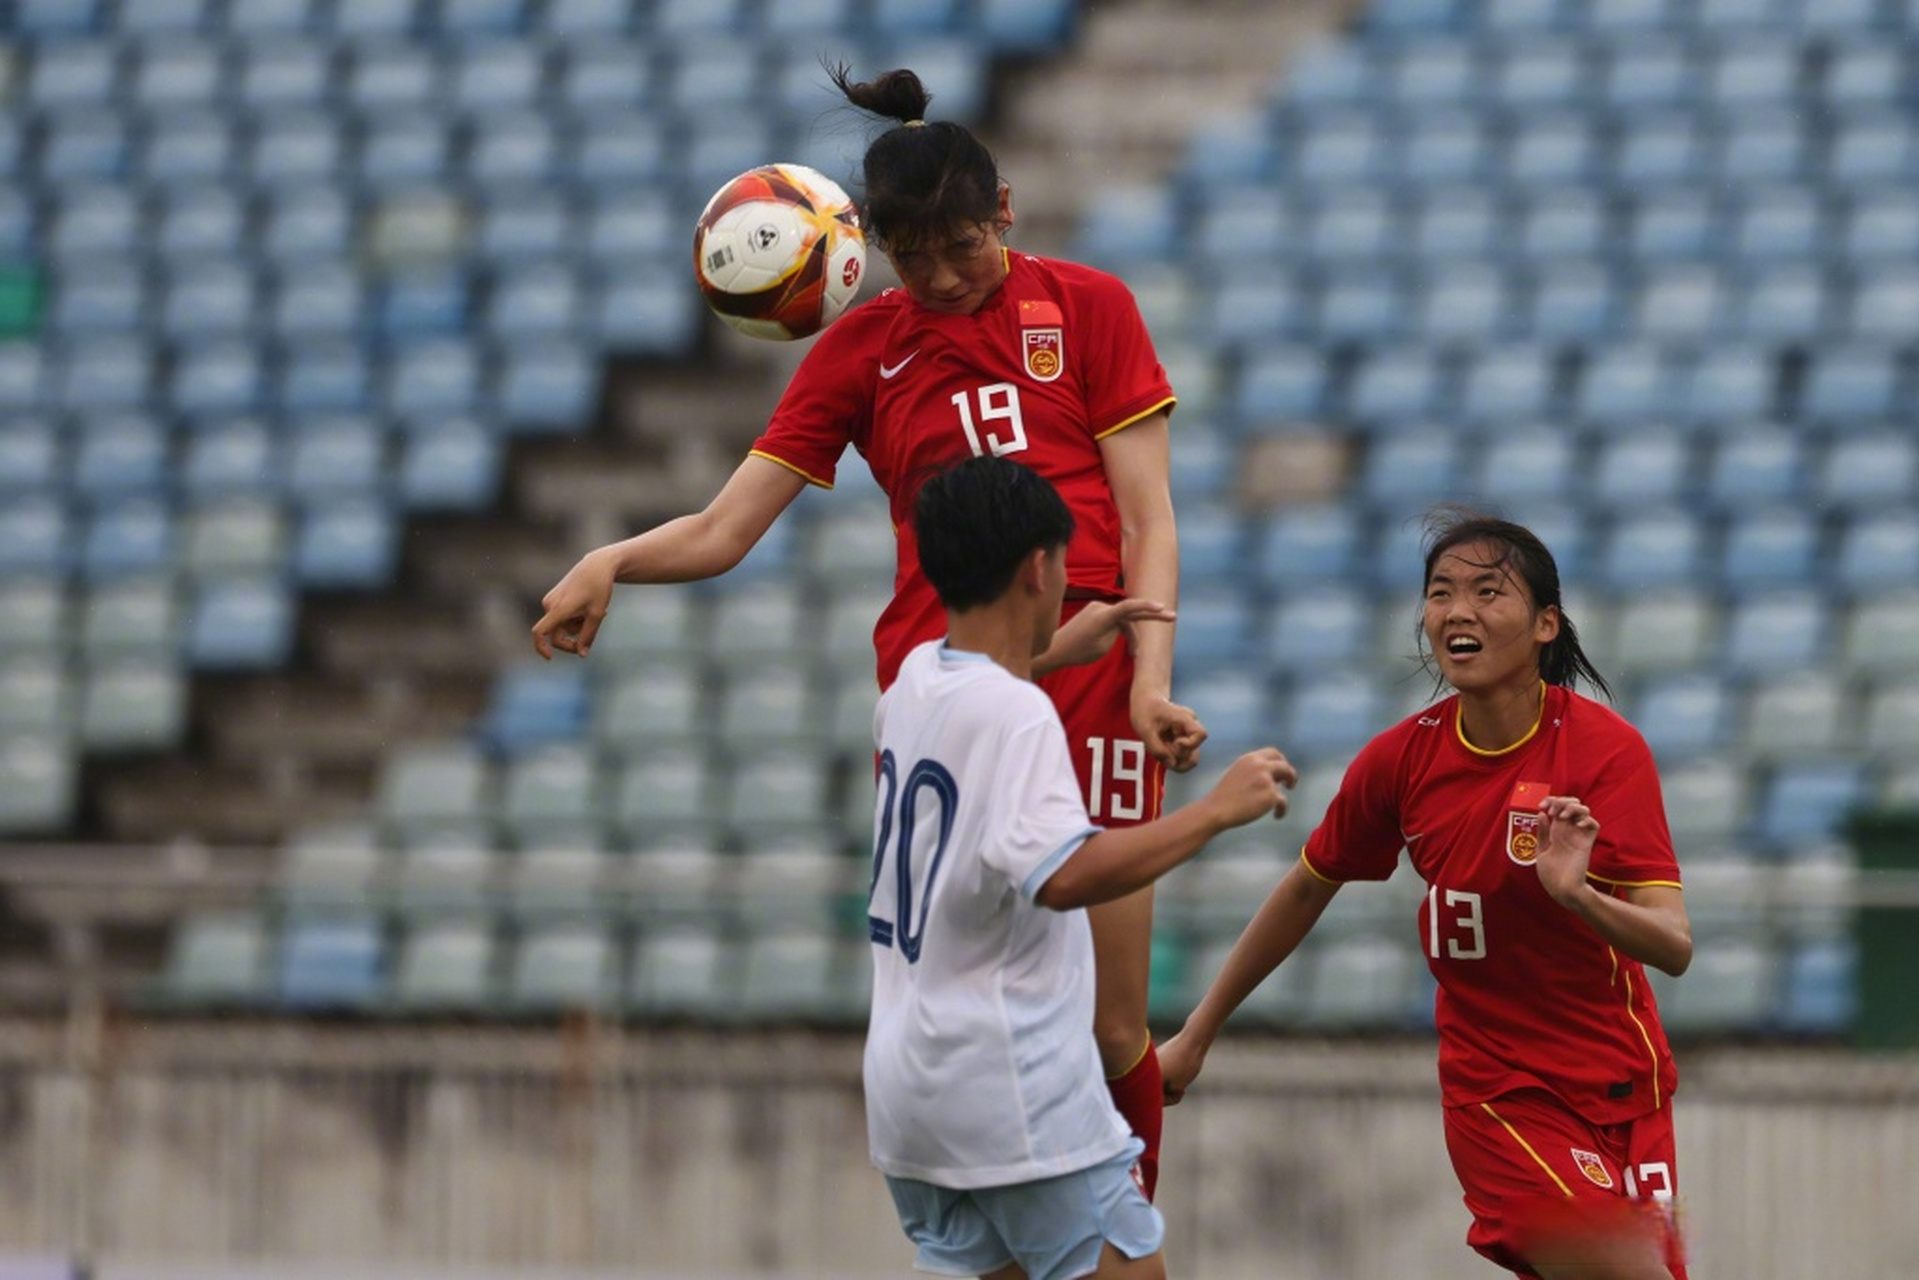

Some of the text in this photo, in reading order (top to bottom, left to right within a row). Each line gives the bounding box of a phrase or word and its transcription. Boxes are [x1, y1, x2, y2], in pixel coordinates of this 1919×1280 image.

[951, 382, 1028, 457] 19
[1086, 737, 1145, 820] 19
[867, 748, 959, 964] 20
[1428, 884, 1487, 960] 13
